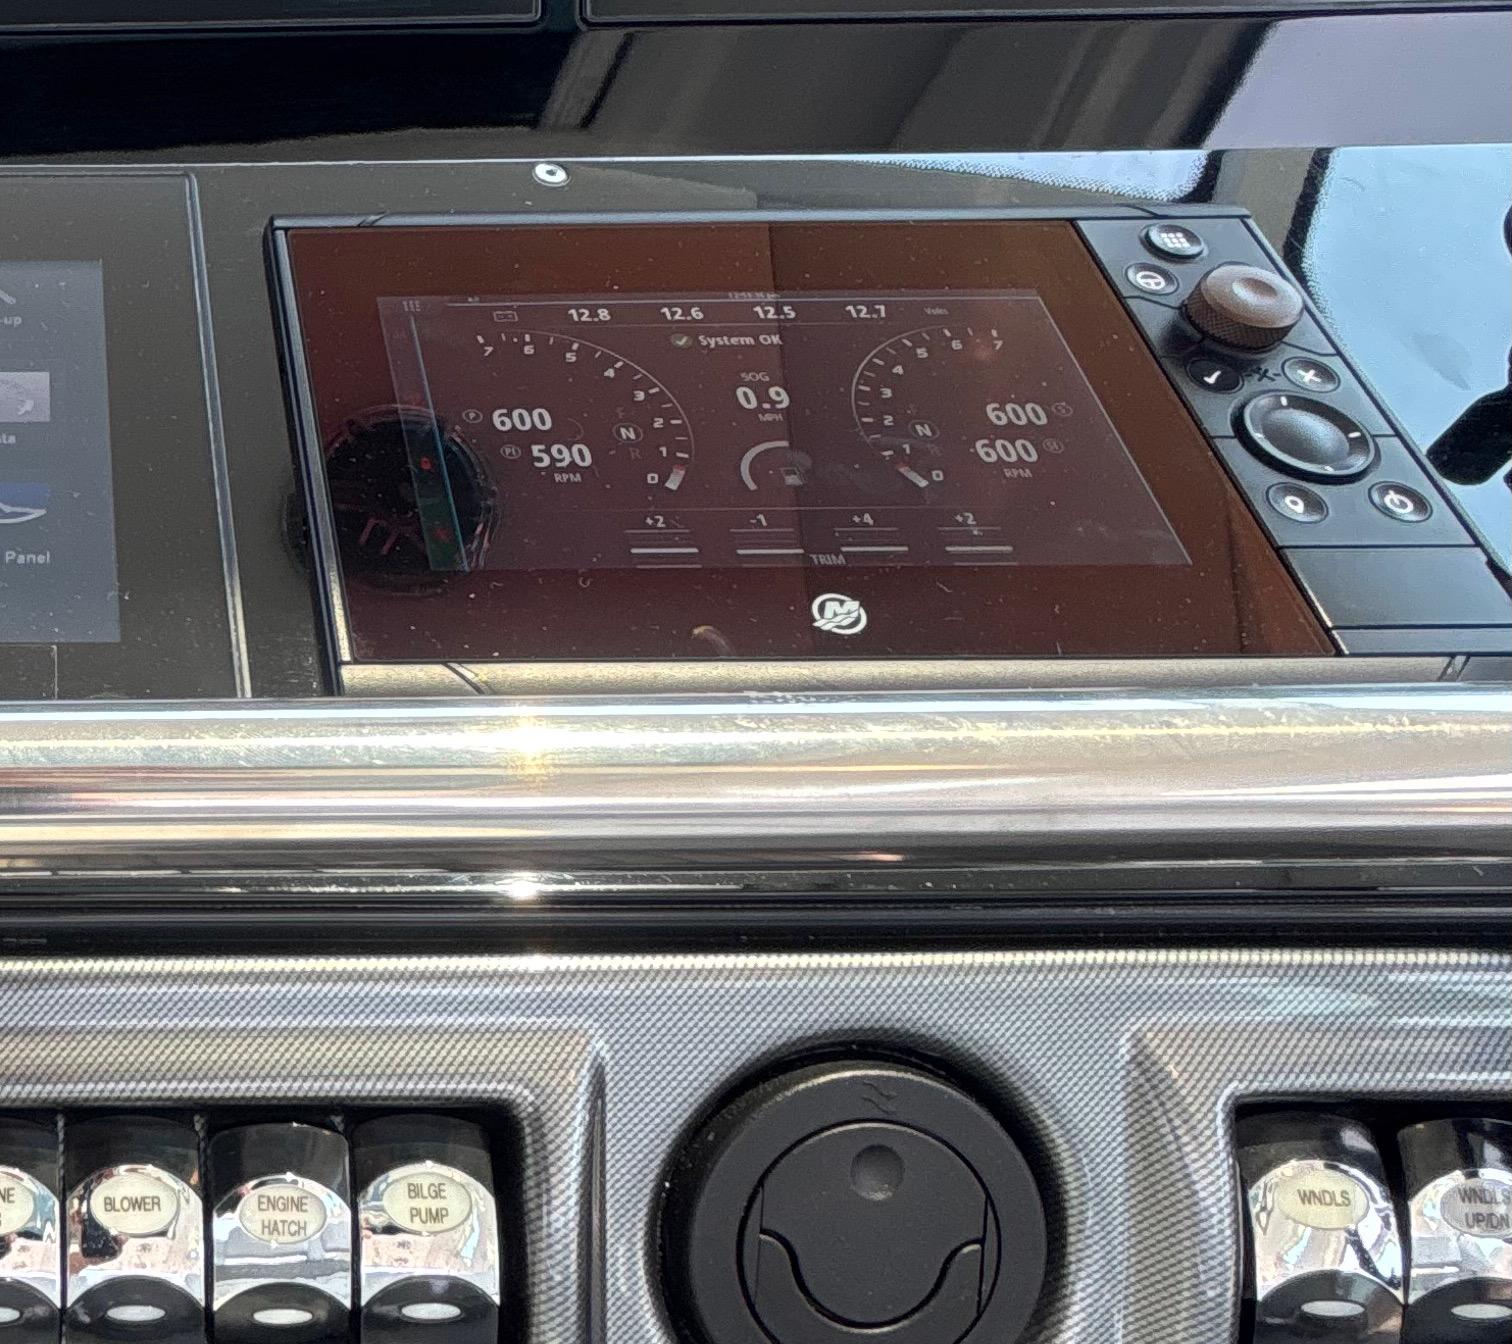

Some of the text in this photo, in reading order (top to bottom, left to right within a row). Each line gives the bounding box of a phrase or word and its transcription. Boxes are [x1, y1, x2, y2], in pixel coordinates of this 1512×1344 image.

[568, 305, 887, 322] 12.8 12.6 12.5 12.7
[698, 334, 783, 347] System OK
[951, 340, 962, 350] 6
[993, 340, 1003, 350] 7
[483, 346, 494, 356] 7
[523, 345, 534, 355] 6
[916, 348, 928, 358] 5
[565, 352, 577, 363] 5
[604, 368, 615, 378] 4
[892, 365, 904, 375] 4
[740, 372, 770, 382] SOG
[633, 390, 645, 401] 3
[736, 386, 789, 409] 0.9
[880, 388, 892, 398] 3
[492, 408, 552, 431] 600
[986, 403, 1048, 426] 600
[652, 417, 664, 428] 2
[883, 415, 894, 426] 2
[620, 428, 636, 439] N
[916, 424, 933, 436] N
[659, 447, 667, 457] 1
[902, 444, 910, 454] 1
[976, 439, 1038, 462] 600
[531, 444, 592, 467] 590
[554, 473, 581, 483] RPM
[647, 473, 658, 484] 0
[932, 470, 944, 481] 0
[1003, 468, 1033, 478] RPM
[5, 551, 51, 565] Panel
[810, 555, 846, 566] TRIM
[407, 1182, 448, 1200] BILGE
[1297, 1188, 1352, 1207] WNDLS
[103, 1195, 162, 1213] BLOWER
[257, 1195, 309, 1213] ENGINE
[409, 1206, 450, 1224] PUMP
[1465, 1212, 1510, 1229] UP/DN
[260, 1218, 308, 1237] HATCH
